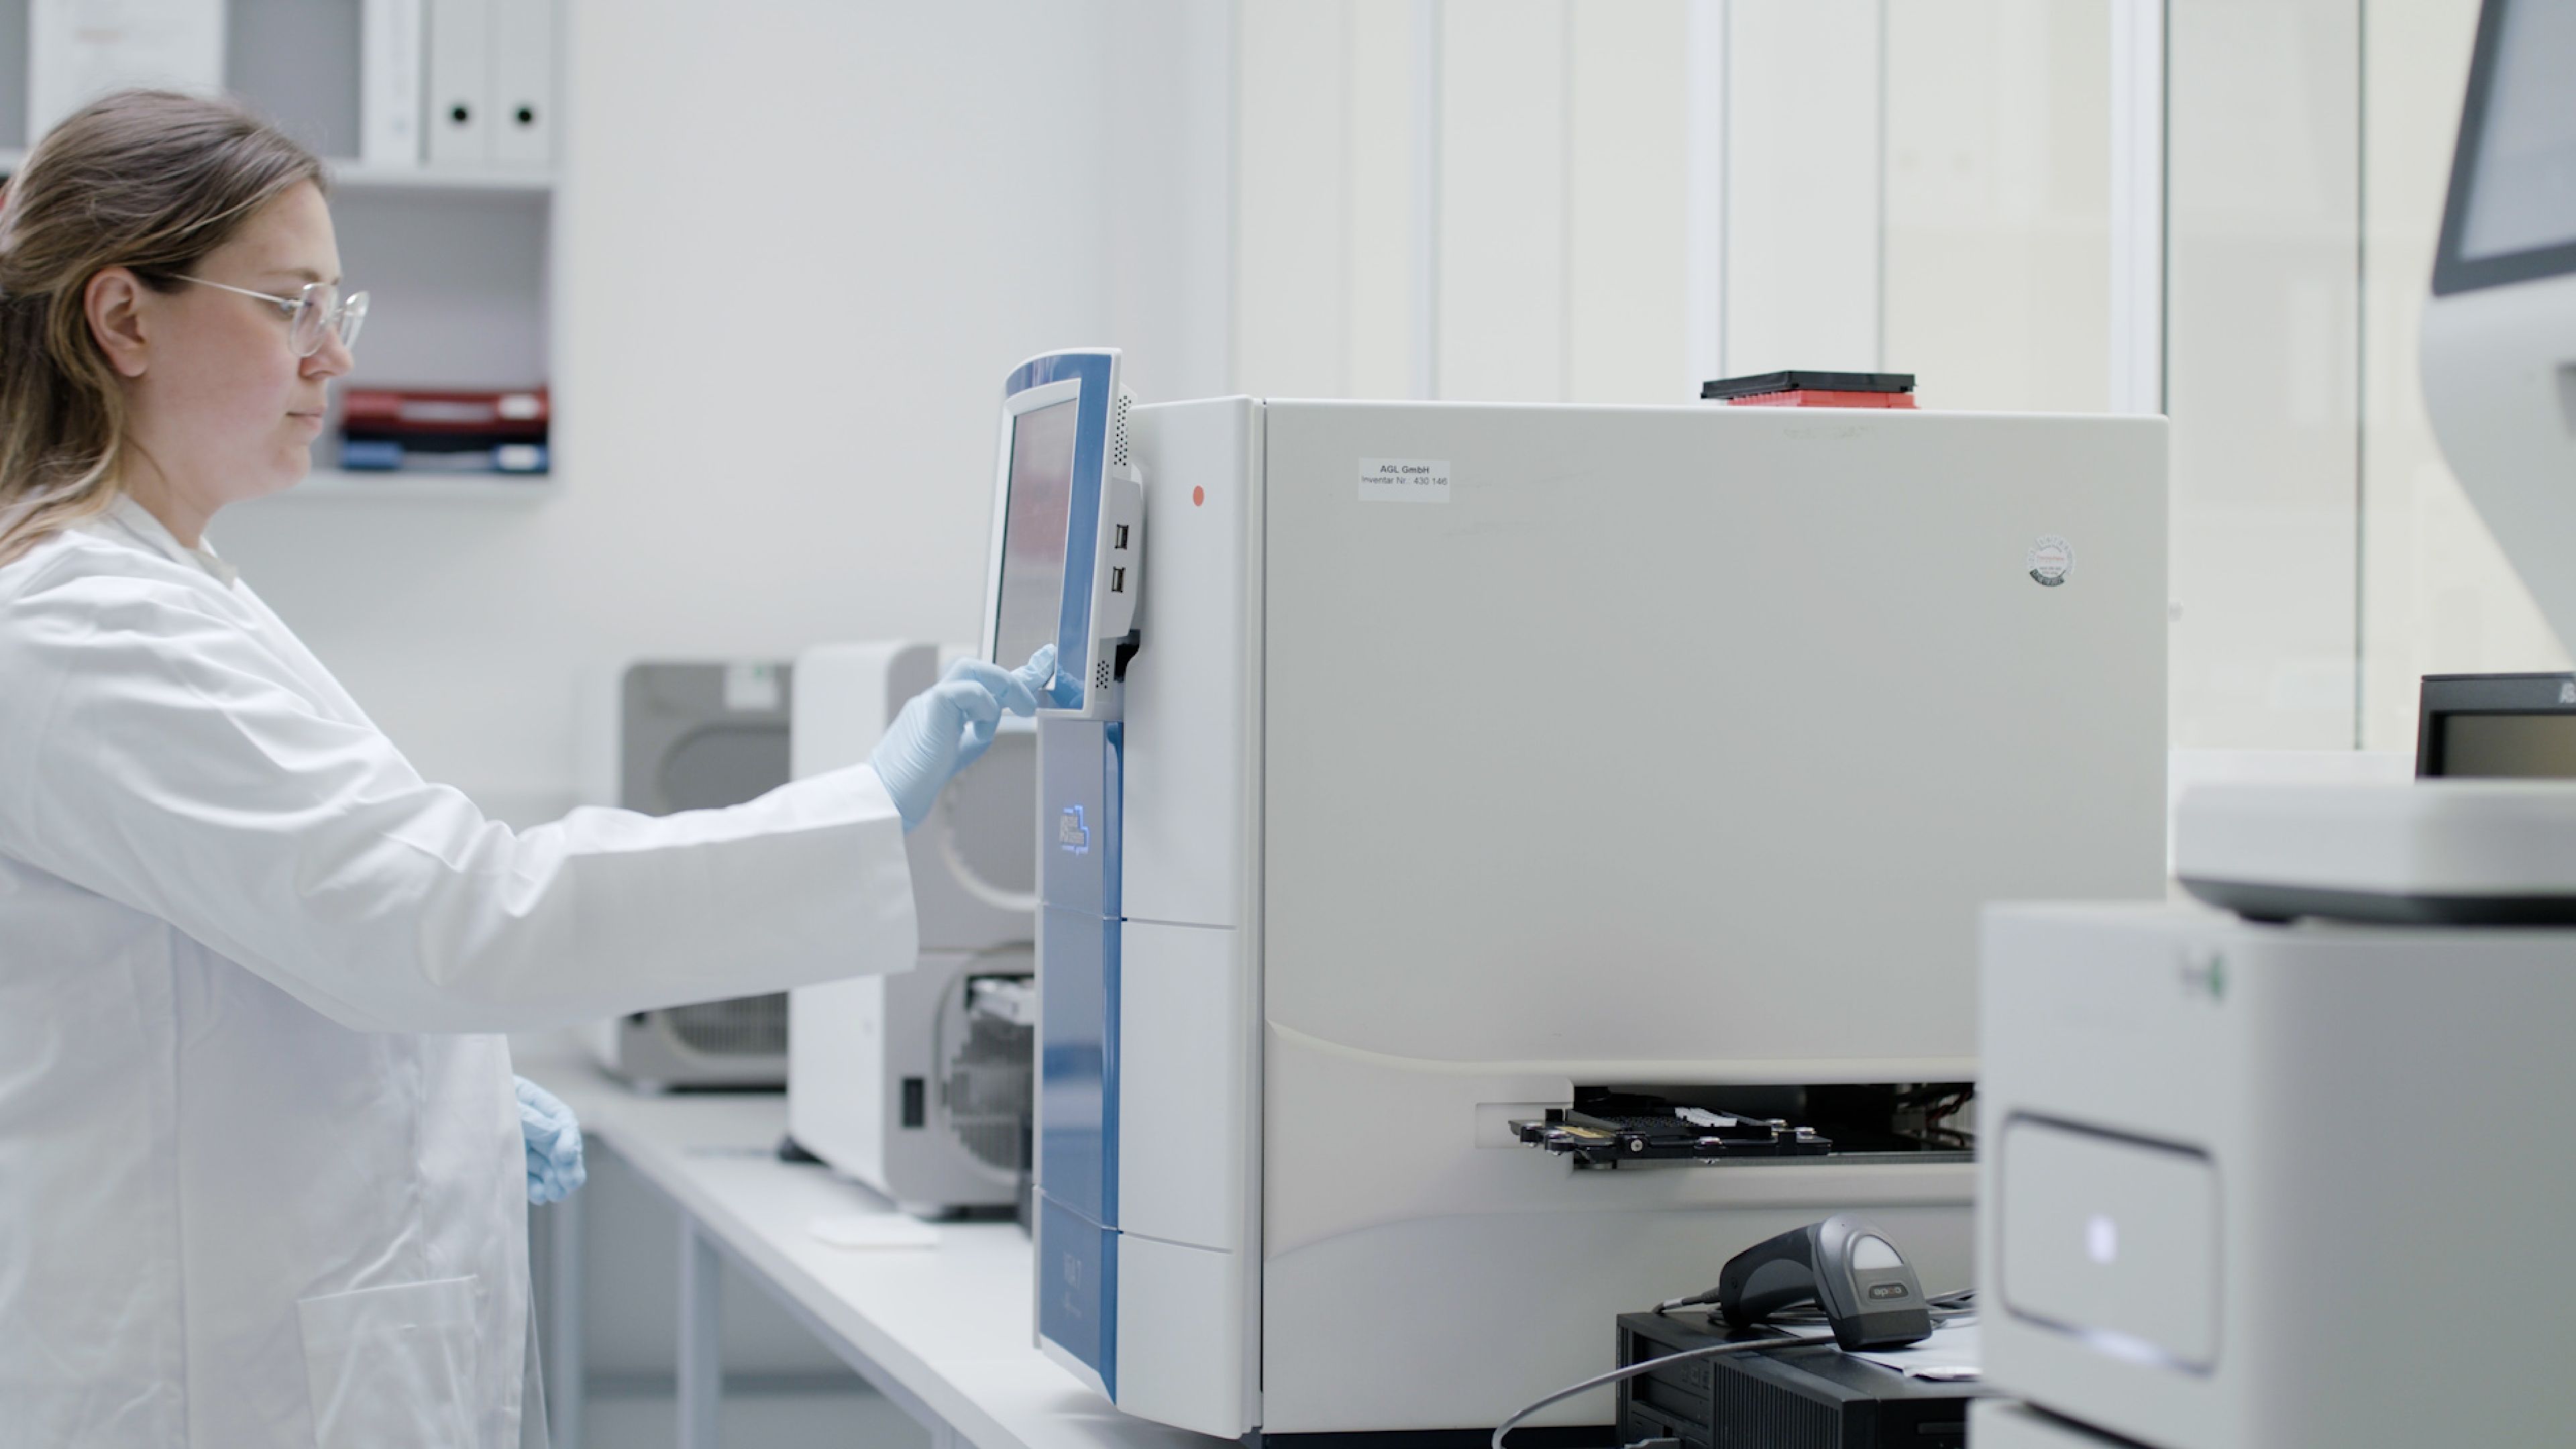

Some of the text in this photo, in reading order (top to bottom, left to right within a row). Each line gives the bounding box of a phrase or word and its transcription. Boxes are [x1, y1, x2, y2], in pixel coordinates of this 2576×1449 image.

[1379, 464, 1430, 474] AGL GmbH
[1362, 475, 1394, 484] Inventar
